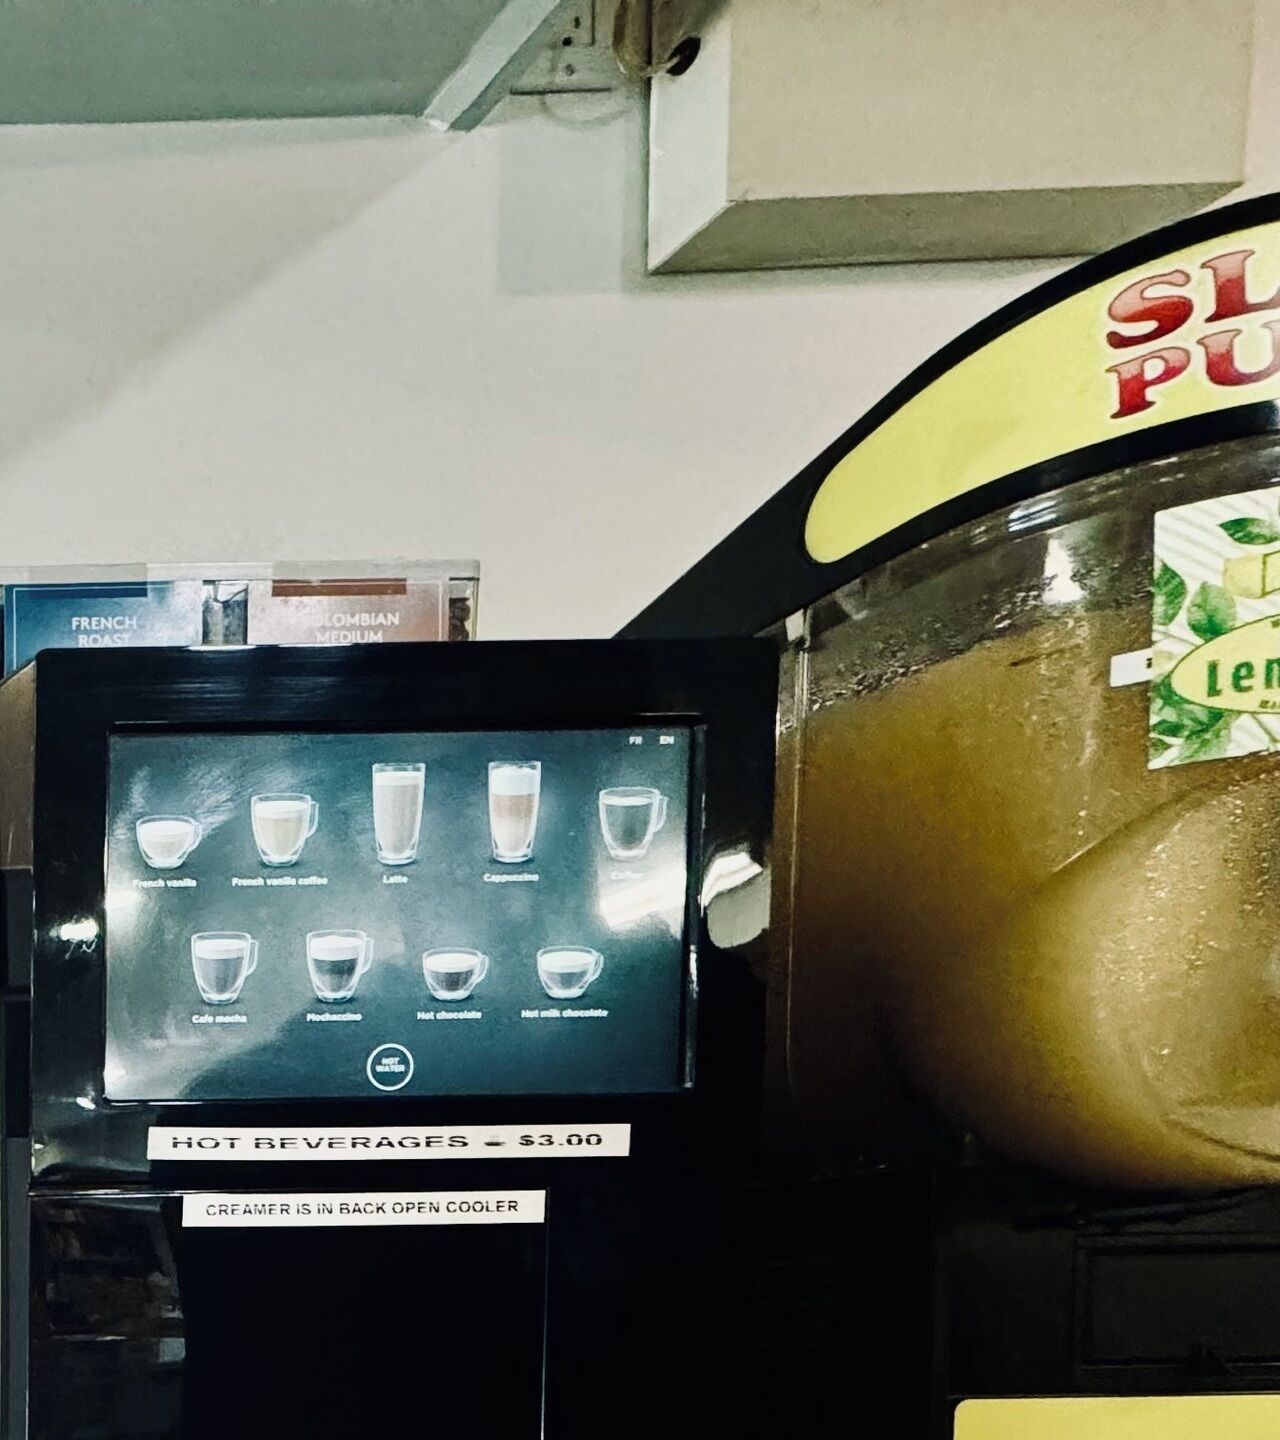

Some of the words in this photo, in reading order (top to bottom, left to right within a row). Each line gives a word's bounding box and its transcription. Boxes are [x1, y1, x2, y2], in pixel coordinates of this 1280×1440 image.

[72, 616, 137, 630] FRENCH
[306, 612, 400, 627] OLOMBIAN
[78, 633, 129, 646] ROAST
[317, 630, 383, 642] MEDIUM
[133, 878, 165, 888] French
[166, 878, 197, 887] vanilla
[232, 877, 264, 886] French
[266, 876, 296, 886] vanilla
[297, 877, 328, 886] coffee
[383, 874, 408, 884] Latte
[483, 873, 539, 883] Cappuccino
[215, 1014, 247, 1023] mocha
[306, 1012, 362, 1022] Mochaccino
[417, 1011, 435, 1020] Hot
[436, 1010, 482, 1020] chocolate
[521, 1009, 539, 1018] Hot
[540, 1009, 561, 1018] milk
[562, 1009, 609, 1018] chocolate
[375, 1064, 406, 1073] WATER
[173, 1137, 240, 1148] HOT
[255, 1136, 468, 1149] BEVERAGES
[519, 1134, 602, 1146] $3.00
[206, 1204, 290, 1215] CREAMER
[297, 1204, 311, 1214] IS
[318, 1204, 332, 1214] IN
[340, 1203, 385, 1214] BACK
[392, 1202, 439, 1213] OPEN
[446, 1201, 518, 1212] COOLER
